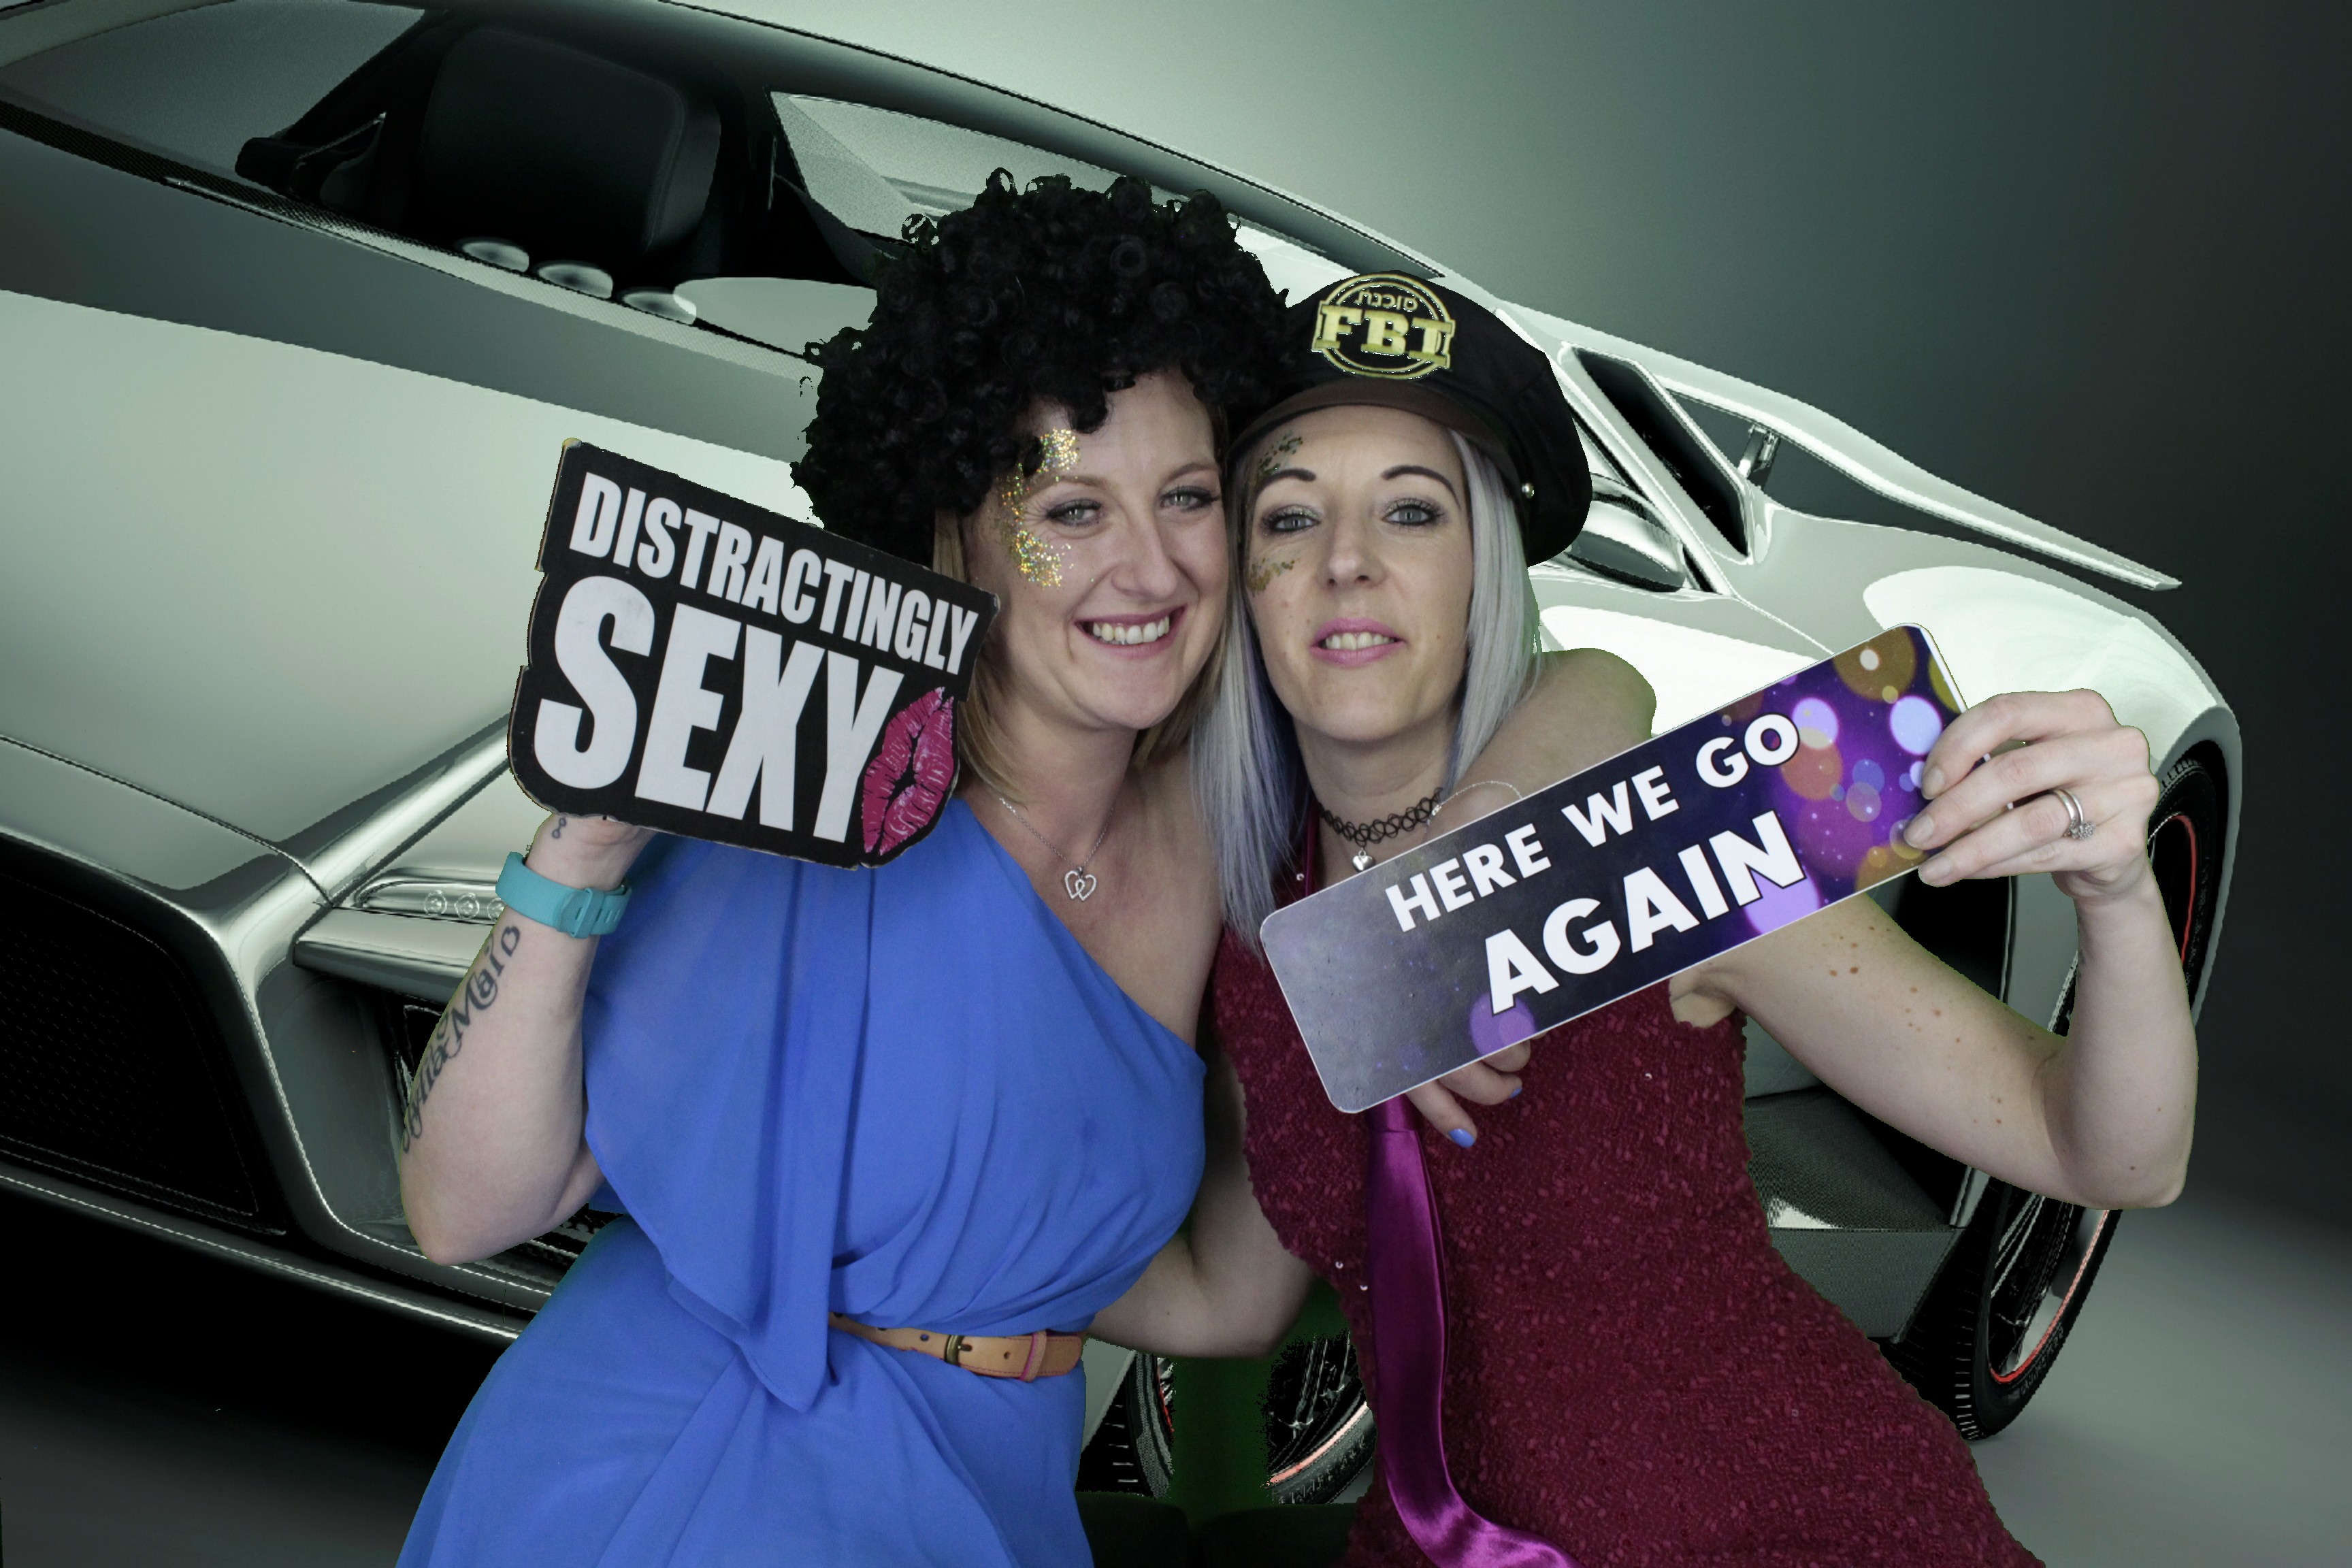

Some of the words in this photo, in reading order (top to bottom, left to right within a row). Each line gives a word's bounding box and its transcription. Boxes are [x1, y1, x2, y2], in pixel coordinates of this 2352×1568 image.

[1313, 306, 1454, 366] FBI
[1354, 290, 1418, 311] סוכנת
[569, 472, 979, 674] DISTRACTINGLY
[534, 576, 904, 843] SEXY
[1384, 823, 1552, 932] HERE
[1561, 765, 1680, 847] WE
[1696, 713, 1799, 788] GO
[1485, 811, 1805, 1014] AGAIN
